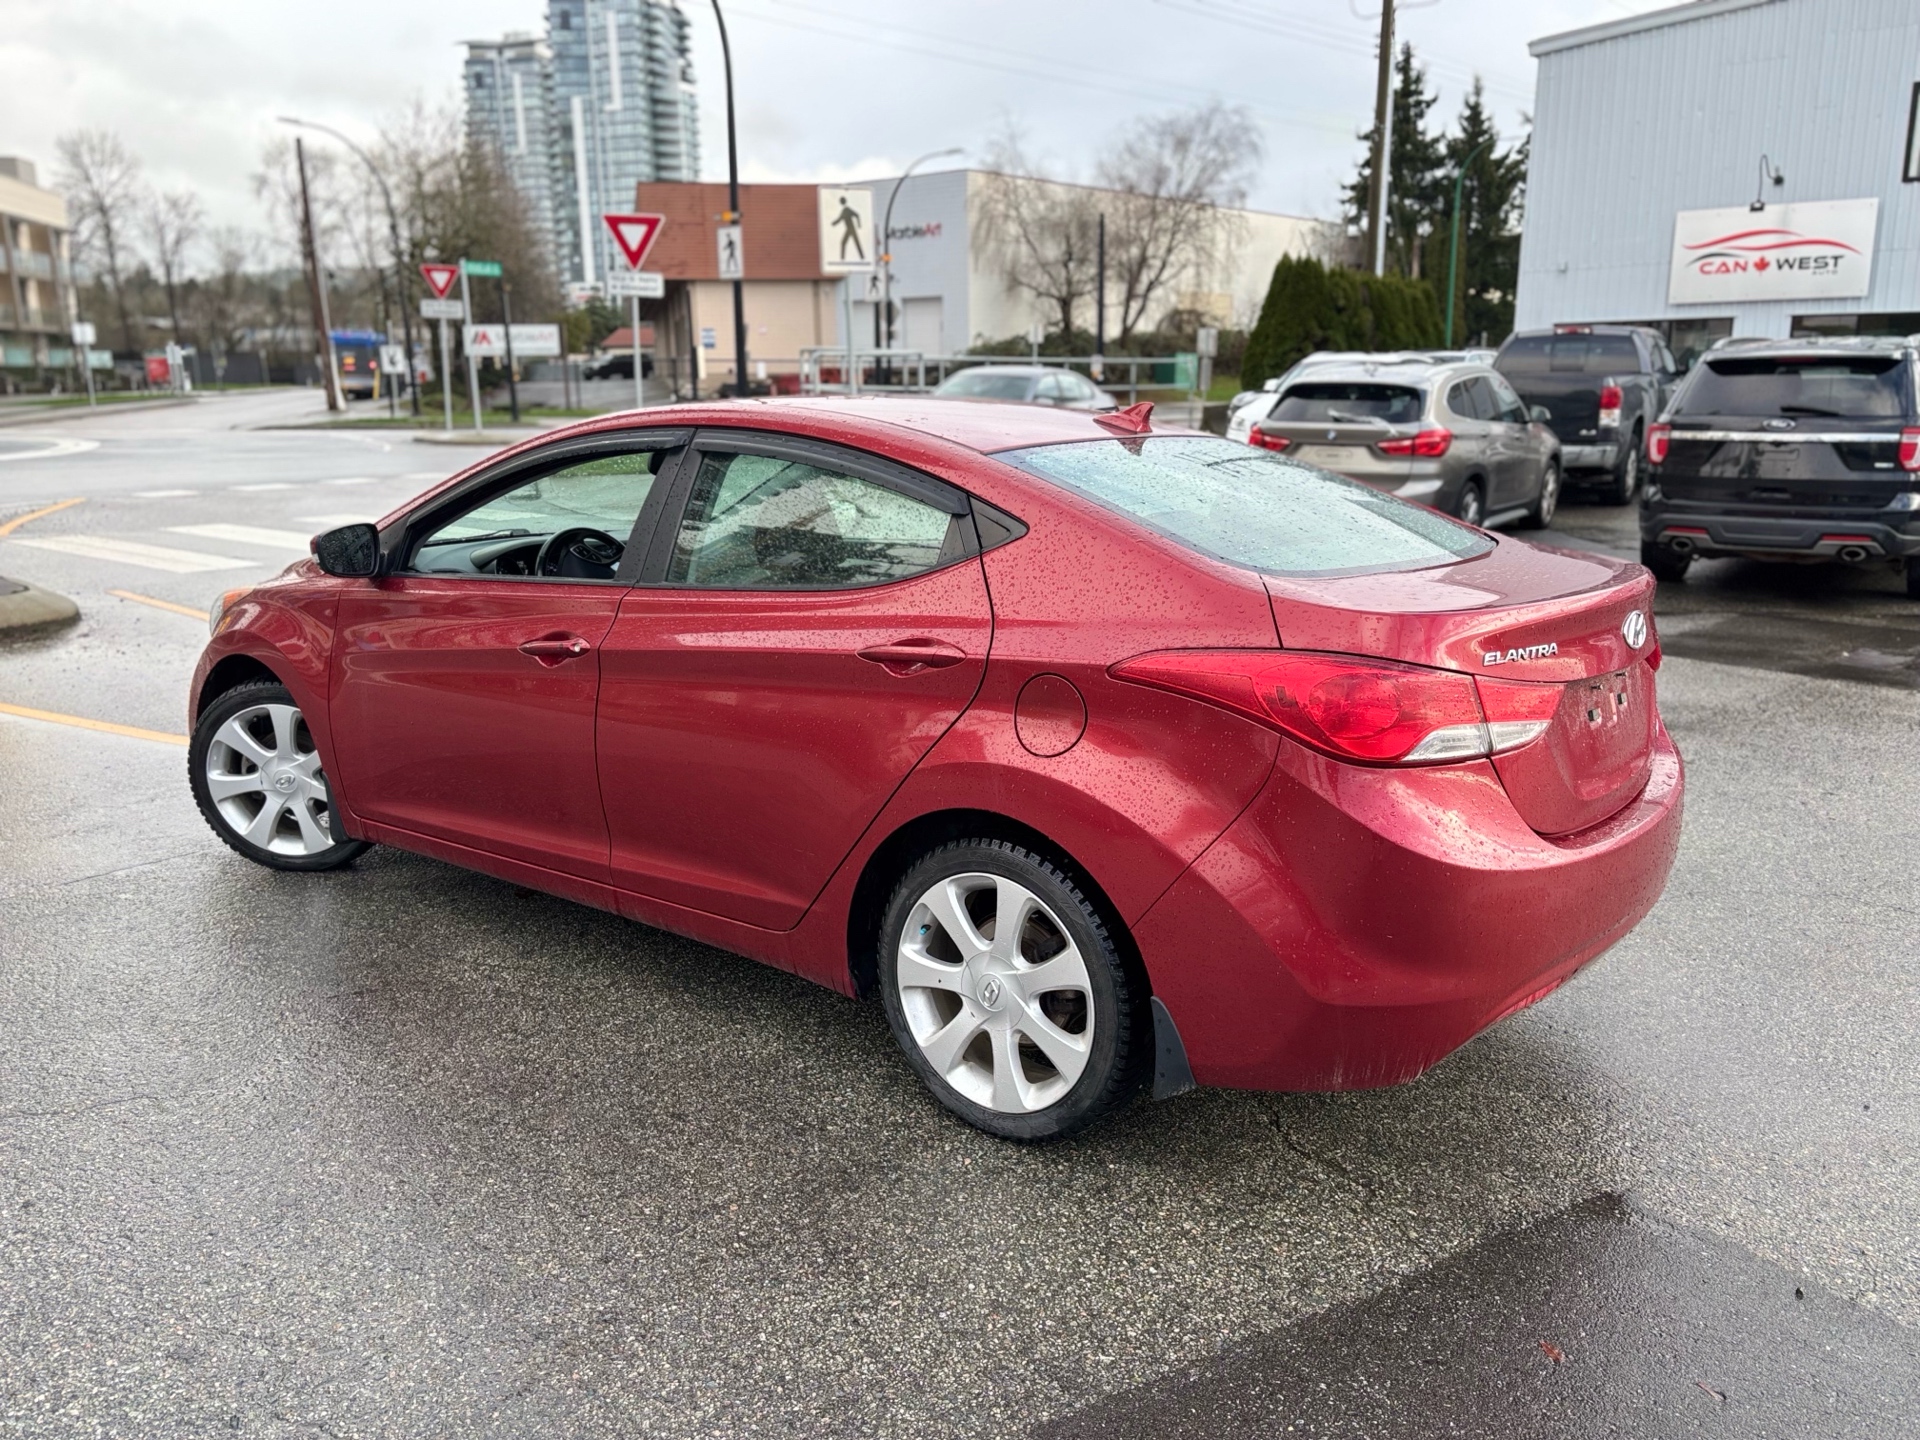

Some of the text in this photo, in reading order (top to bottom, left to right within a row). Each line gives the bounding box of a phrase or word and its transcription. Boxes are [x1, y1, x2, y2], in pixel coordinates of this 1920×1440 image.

[1698, 255, 1845, 275] CAN WEST
[1483, 642, 1559, 667] ELANTRA
